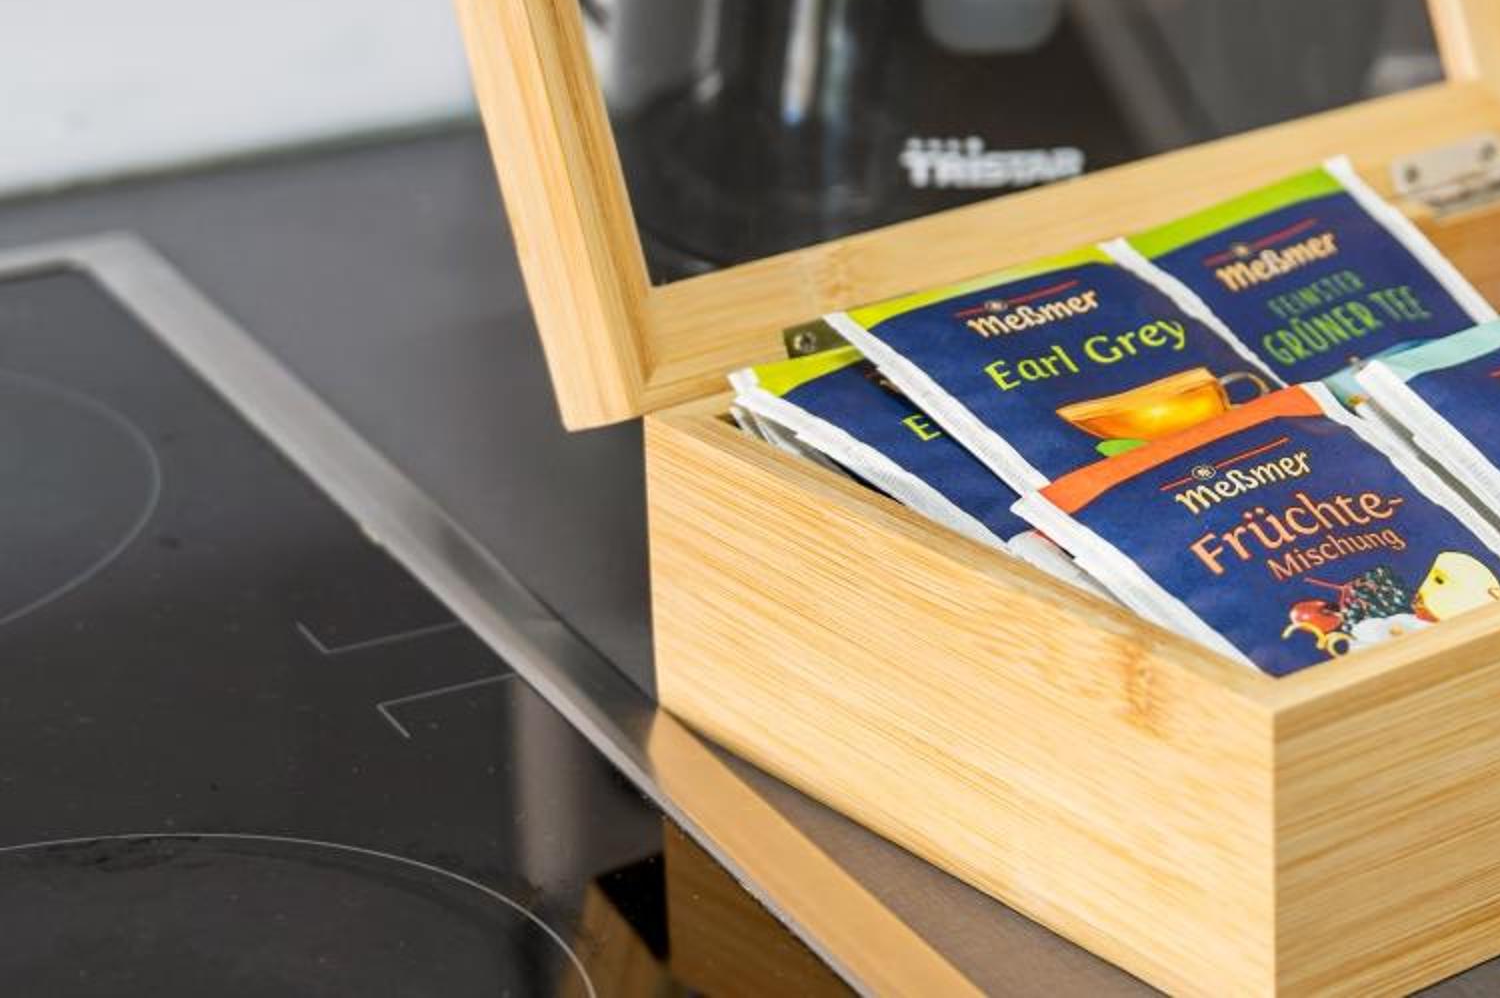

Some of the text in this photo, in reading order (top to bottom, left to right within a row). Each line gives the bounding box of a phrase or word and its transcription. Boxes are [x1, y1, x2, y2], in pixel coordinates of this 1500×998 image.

[1214, 232, 1338, 292] Meßmer
[966, 290, 1099, 338] Meßmer
[1267, 270, 1365, 318] FEINSTER
[1367, 285, 1431, 320] TEE
[984, 320, 1186, 391] Earl Grey
[1175, 451, 1312, 514] Meßmer
[1190, 492, 1404, 574] Früchte-
[1266, 529, 1406, 581] Mischung
